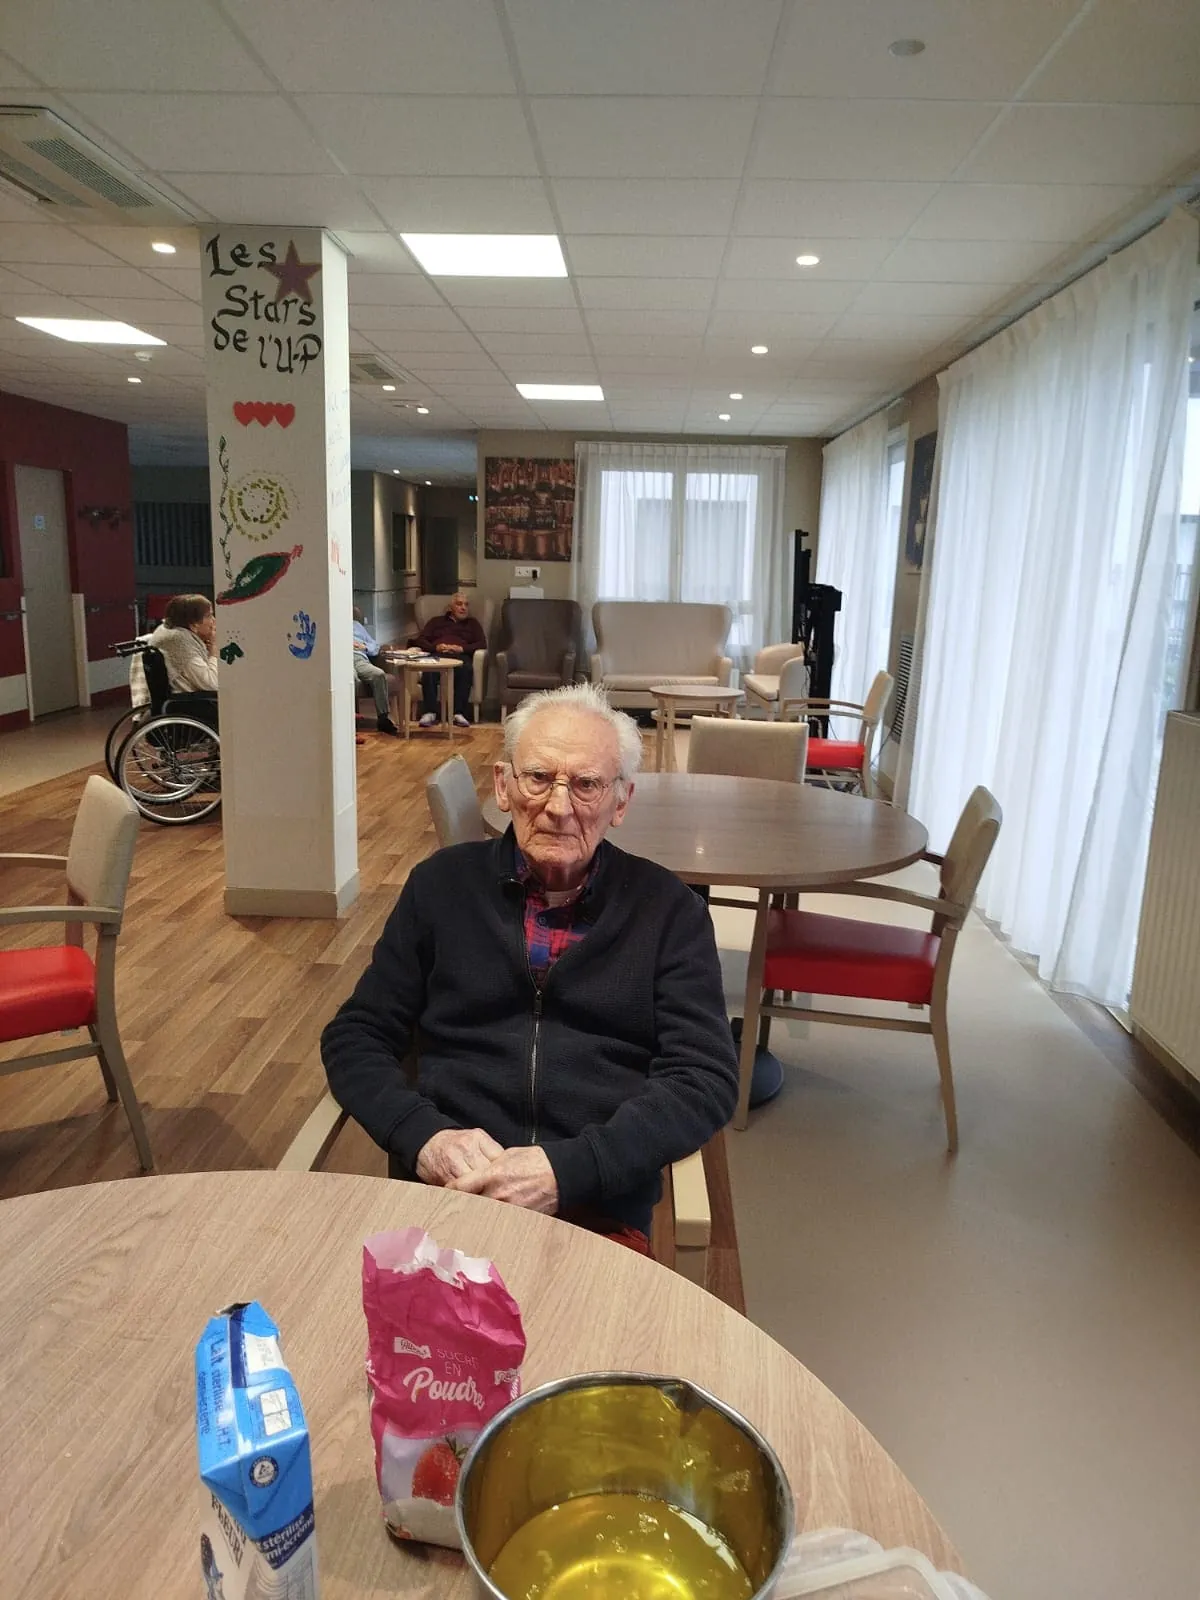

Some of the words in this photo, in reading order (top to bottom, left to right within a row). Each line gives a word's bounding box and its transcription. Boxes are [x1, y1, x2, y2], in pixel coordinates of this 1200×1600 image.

[206, 233, 277, 277] Les
[217, 284, 316, 326] Stars
[211, 316, 249, 352] de
[444, 1363, 462, 1377] EN
